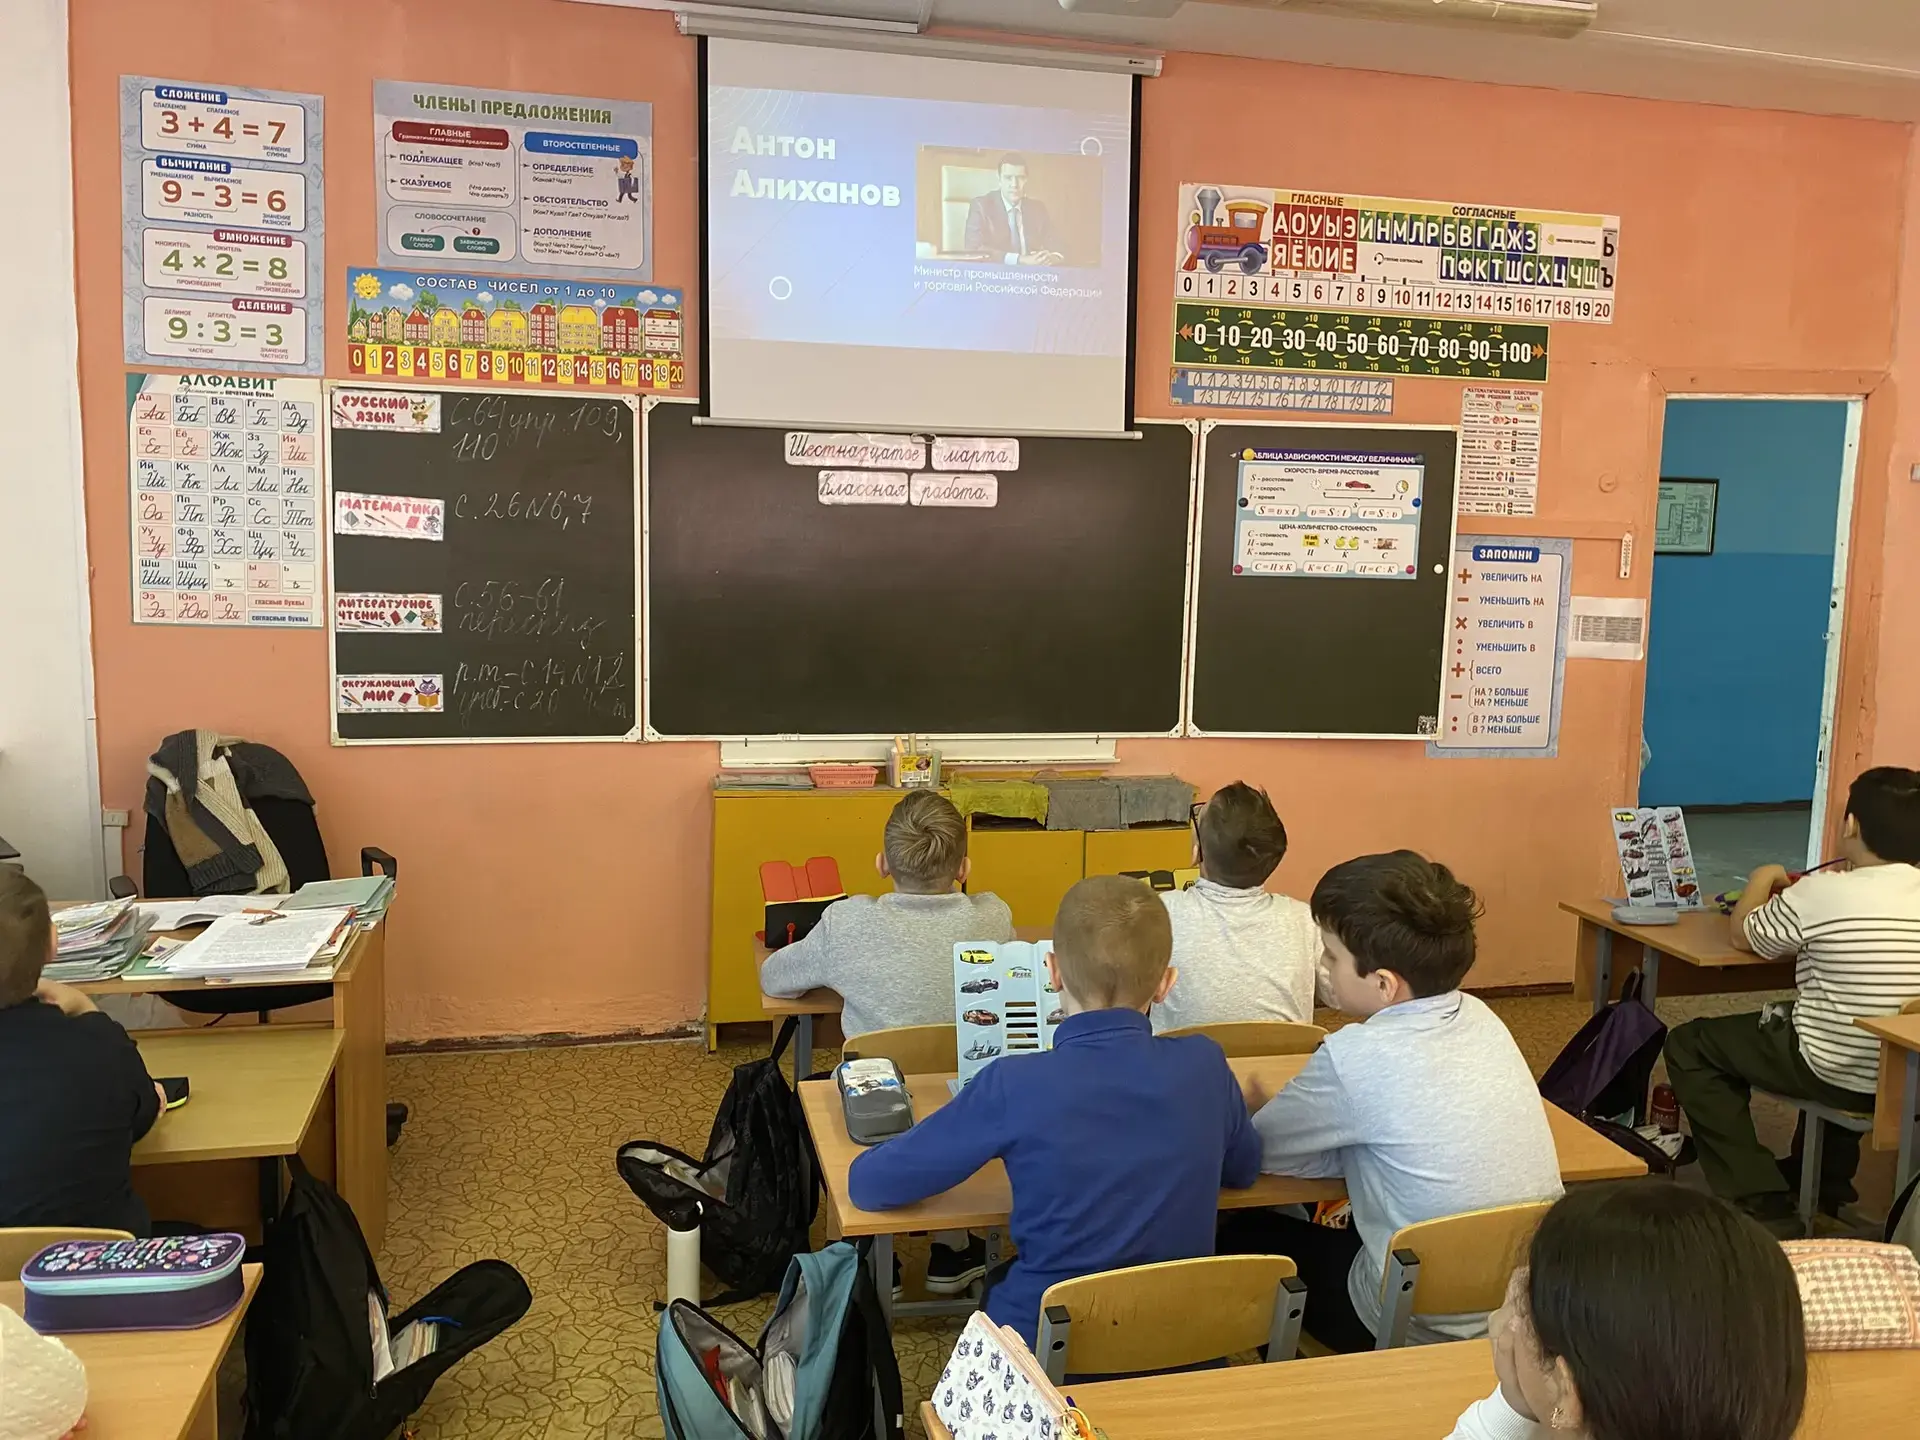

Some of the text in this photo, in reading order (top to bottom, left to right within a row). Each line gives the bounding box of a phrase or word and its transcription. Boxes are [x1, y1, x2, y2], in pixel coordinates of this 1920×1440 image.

[161, 88, 221, 103] СЛОЖЕНИЕ
[413, 94, 612, 124] ЧЛЕНЫ ПРЕДЛОЖЕНИЯ
[161, 111, 178, 133] 3
[213, 117, 233, 139] 4
[268, 122, 286, 143] 7
[430, 128, 471, 138] ГЛАВНЫЕ
[543, 140, 620, 152] ВТОРОСТЕПЕННЫЕ
[730, 126, 836, 160] Антон
[161, 158, 227, 172] ВЫЧИТАНИЕ
[400, 154, 463, 165] ПОДЛЕЖАЩЕЕ
[533, 164, 593, 173] ОПРЕДЕЛЕНИЕ
[400, 178, 451, 188] СКАЗУЕМОЕ
[730, 169, 901, 208] Алиханов
[162, 181, 181, 202] 9
[215, 186, 232, 207] 3
[268, 190, 286, 212] 6
[533, 196, 608, 207] ОБСТОЯТЕЛЬСТВО
[1291, 194, 1343, 206] ГЛАСНЫЕ
[415, 212, 486, 223] СЛОВОСОЧЕТАНИЕ
[1452, 206, 1516, 219] СОГЛАСНЫЕ
[219, 232, 286, 245] УМНОЖЕНИЕ
[534, 228, 592, 238] ДОПОЛНЕНИЕ
[163, 250, 183, 271] 4
[217, 254, 233, 275] 2
[269, 258, 287, 279] 8
[914, 266, 1058, 282] Министр промышленности
[416, 277, 615, 298] СОСТАВ ЧИСЕЛ от 1 до 10
[924, 282, 972, 293] торговли
[975, 282, 1037, 295] Российской
[1041, 286, 1101, 298] Федерации
[238, 301, 286, 312] ДЕЛЕНИЕ
[168, 317, 188, 339] 9
[214, 320, 230, 342] 3
[266, 325, 282, 345] 3
[1194, 323, 1531, 363] 0 10 20 30 40 50 60 70 80 90 100
[353, 353, 683, 381] 0 1 2 3 4 5 6 7 8 9 10 11 12 13 14 15 16 17 18 19 20
[180, 375, 277, 390] АЛФАВИТ
[342, 395, 408, 409] РУССКИЙ
[356, 412, 395, 423] ЯЗЫК
[453, 433, 498, 460] 110
[790, 434, 919, 464] Шестнадцатое
[1253, 453, 1283, 461] АБЛИЦА
[820, 473, 906, 495] Классная
[340, 498, 440, 515] МАТЕМАТИКА
[1480, 549, 1532, 560] ЗАПОМНИ
[1481, 573, 1528, 582] УВЕЛИЧИТЬ
[338, 599, 432, 609] ЛИТЕРАТУРНОЕ
[1479, 596, 1544, 606] УМЕНЬШИТЬ НА
[338, 611, 385, 621] ЧТЕНИЕ
[1478, 620, 1533, 629] УВЕЛИЧИТЬ В
[1476, 643, 1527, 652] УМЕНЬШИТЬ
[342, 679, 415, 689] ОКРУЖАЮЩИЙ
[363, 690, 395, 701] МИР
[1475, 688, 1486, 696] НА
[1494, 688, 1529, 696] БОЛЬШЕ
[1494, 699, 1528, 707] МЕНЬШЕ
[1487, 726, 1521, 734] МЕНЬШЕ
